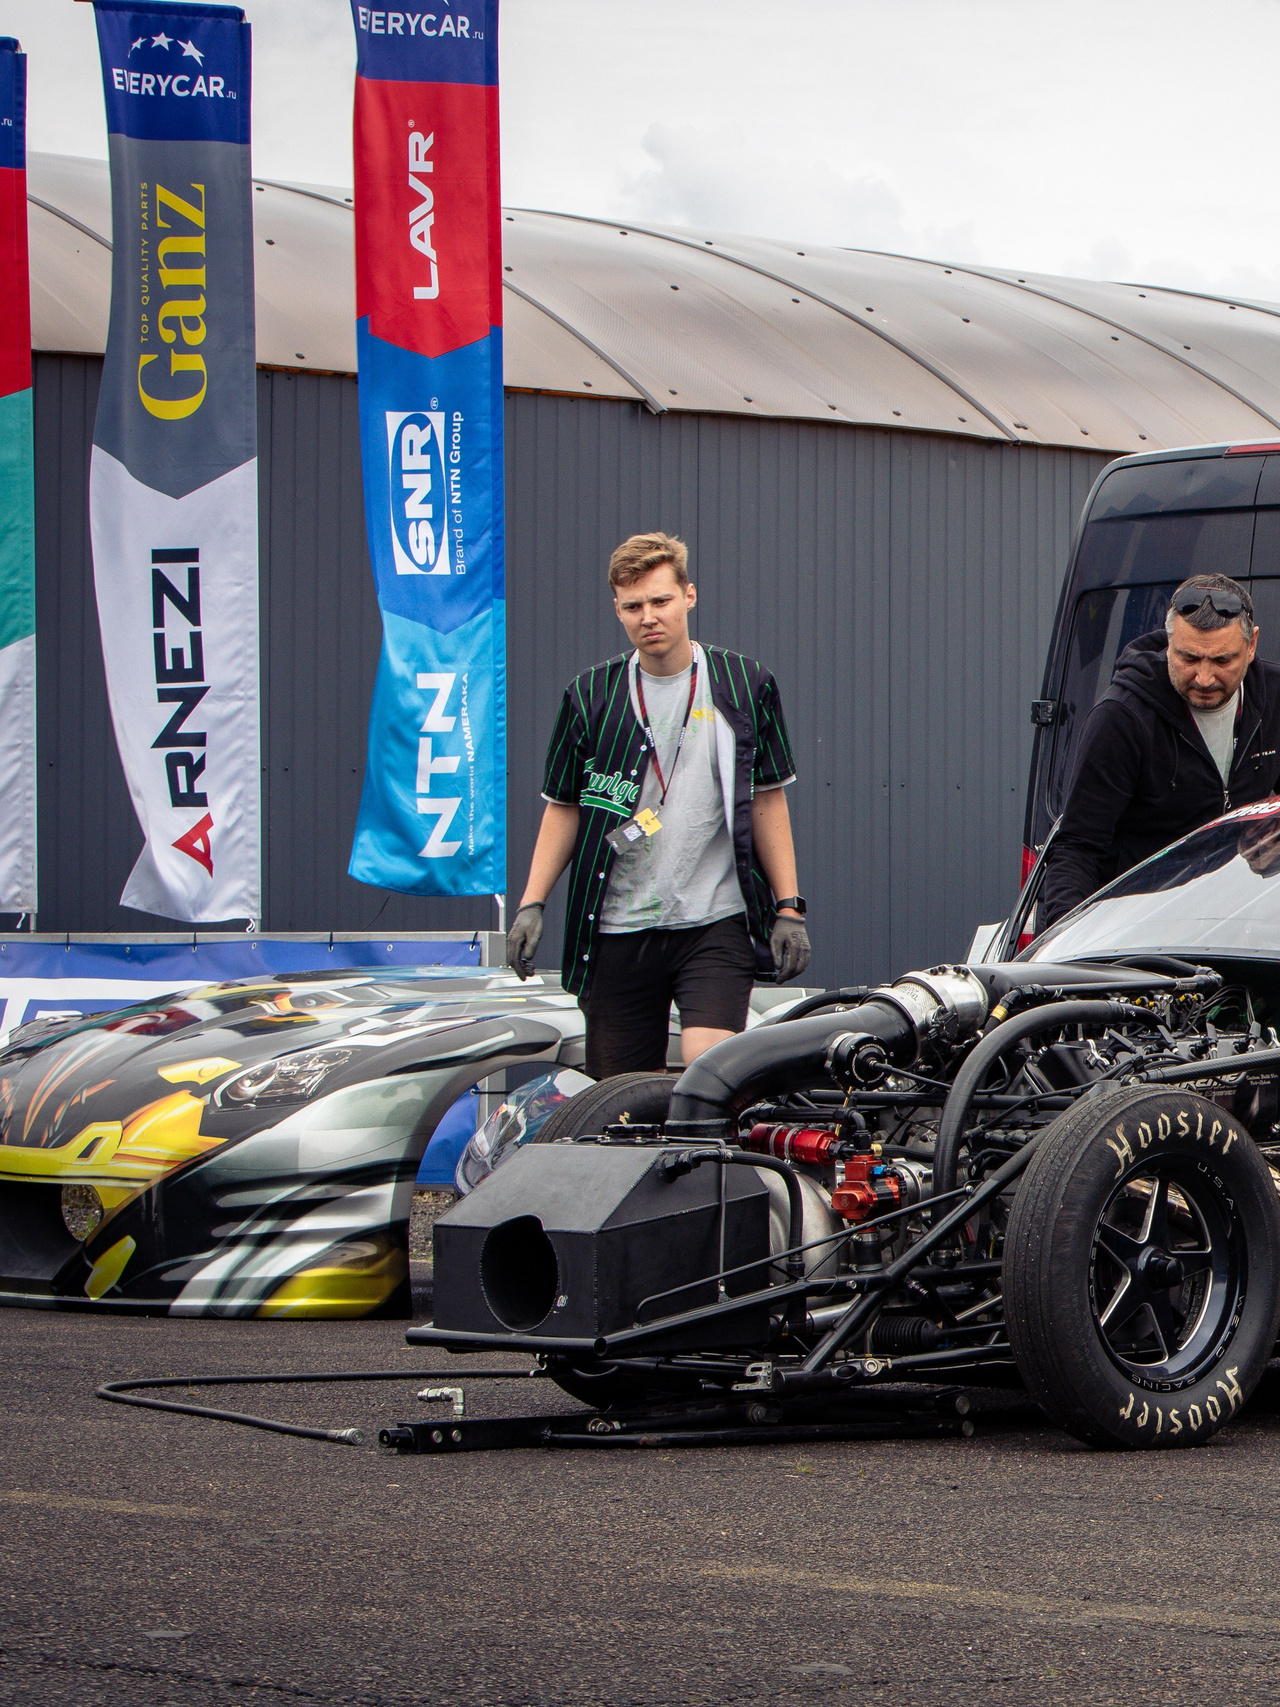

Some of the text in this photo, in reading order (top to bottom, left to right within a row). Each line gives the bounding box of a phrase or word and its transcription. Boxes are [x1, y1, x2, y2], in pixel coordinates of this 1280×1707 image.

[140, 181, 150, 343] TOP QUALITY PARTS
[408, 131, 440, 300] LAVR
[401, 423, 436, 567] SNR
[450, 411, 466, 575] Brand of NTN Group
[150, 547, 215, 880] ARNEZI
[415, 672, 463, 859] NTN
[460, 672, 475, 762] NAMERAKA
[468, 801, 476, 823] the
[1105, 1110, 1239, 1180] Hoosier
[1118, 1365, 1245, 1435] Hoosier
[1131, 1294, 1246, 1392] WELD RACING
